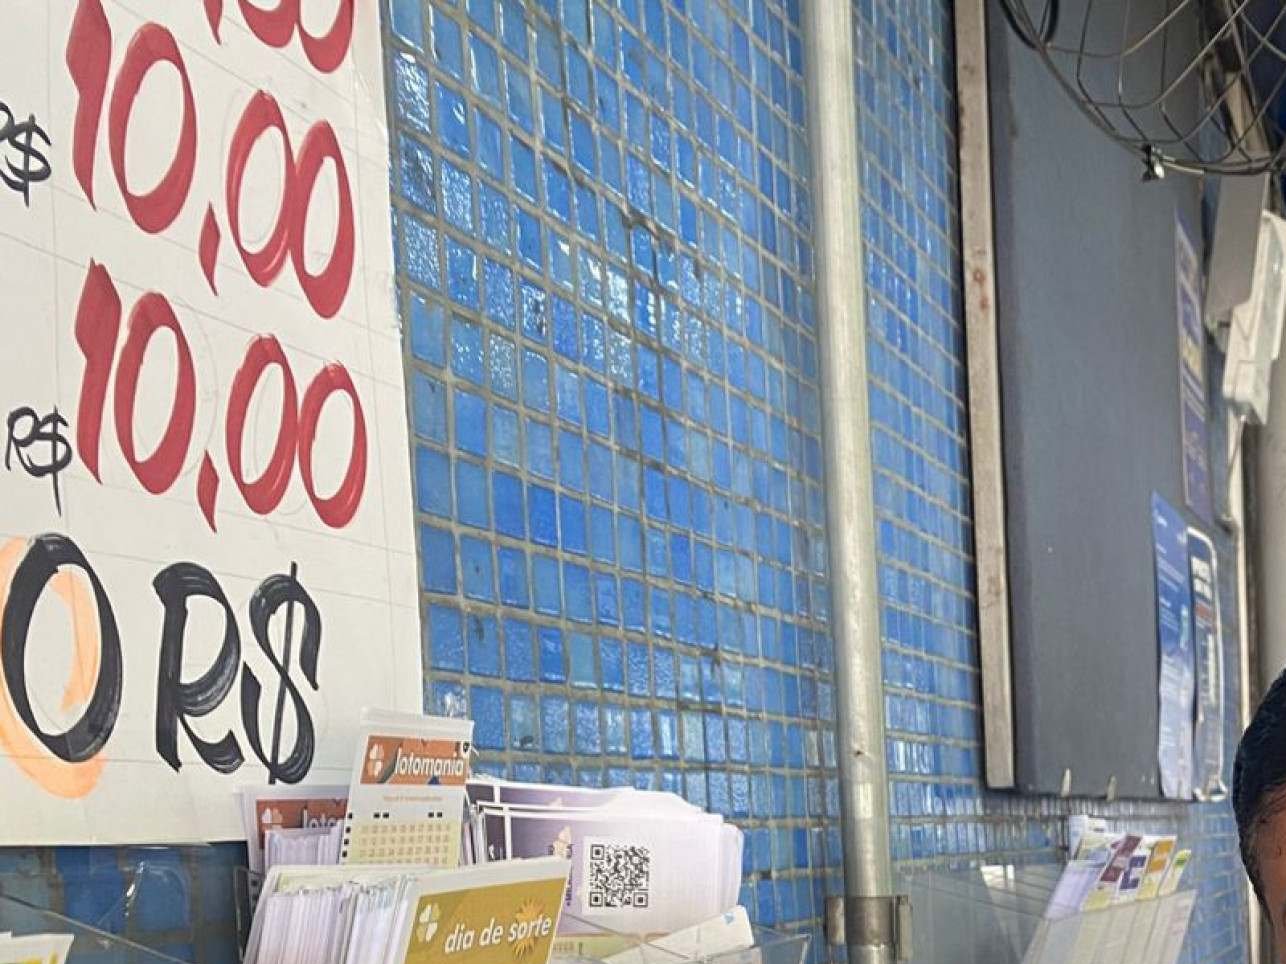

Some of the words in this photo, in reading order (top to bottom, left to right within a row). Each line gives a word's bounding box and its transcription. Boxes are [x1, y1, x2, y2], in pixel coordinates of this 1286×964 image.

[66, 0, 355, 319] 10,00
[5, 404, 72, 517] R$
[75, 257, 368, 533] 10,00
[152, 561, 322, 785] R$
[394, 748, 465, 776] lotomania
[445, 923, 475, 954] dia
[479, 917, 504, 947] de
[508, 914, 552, 942] sorte
